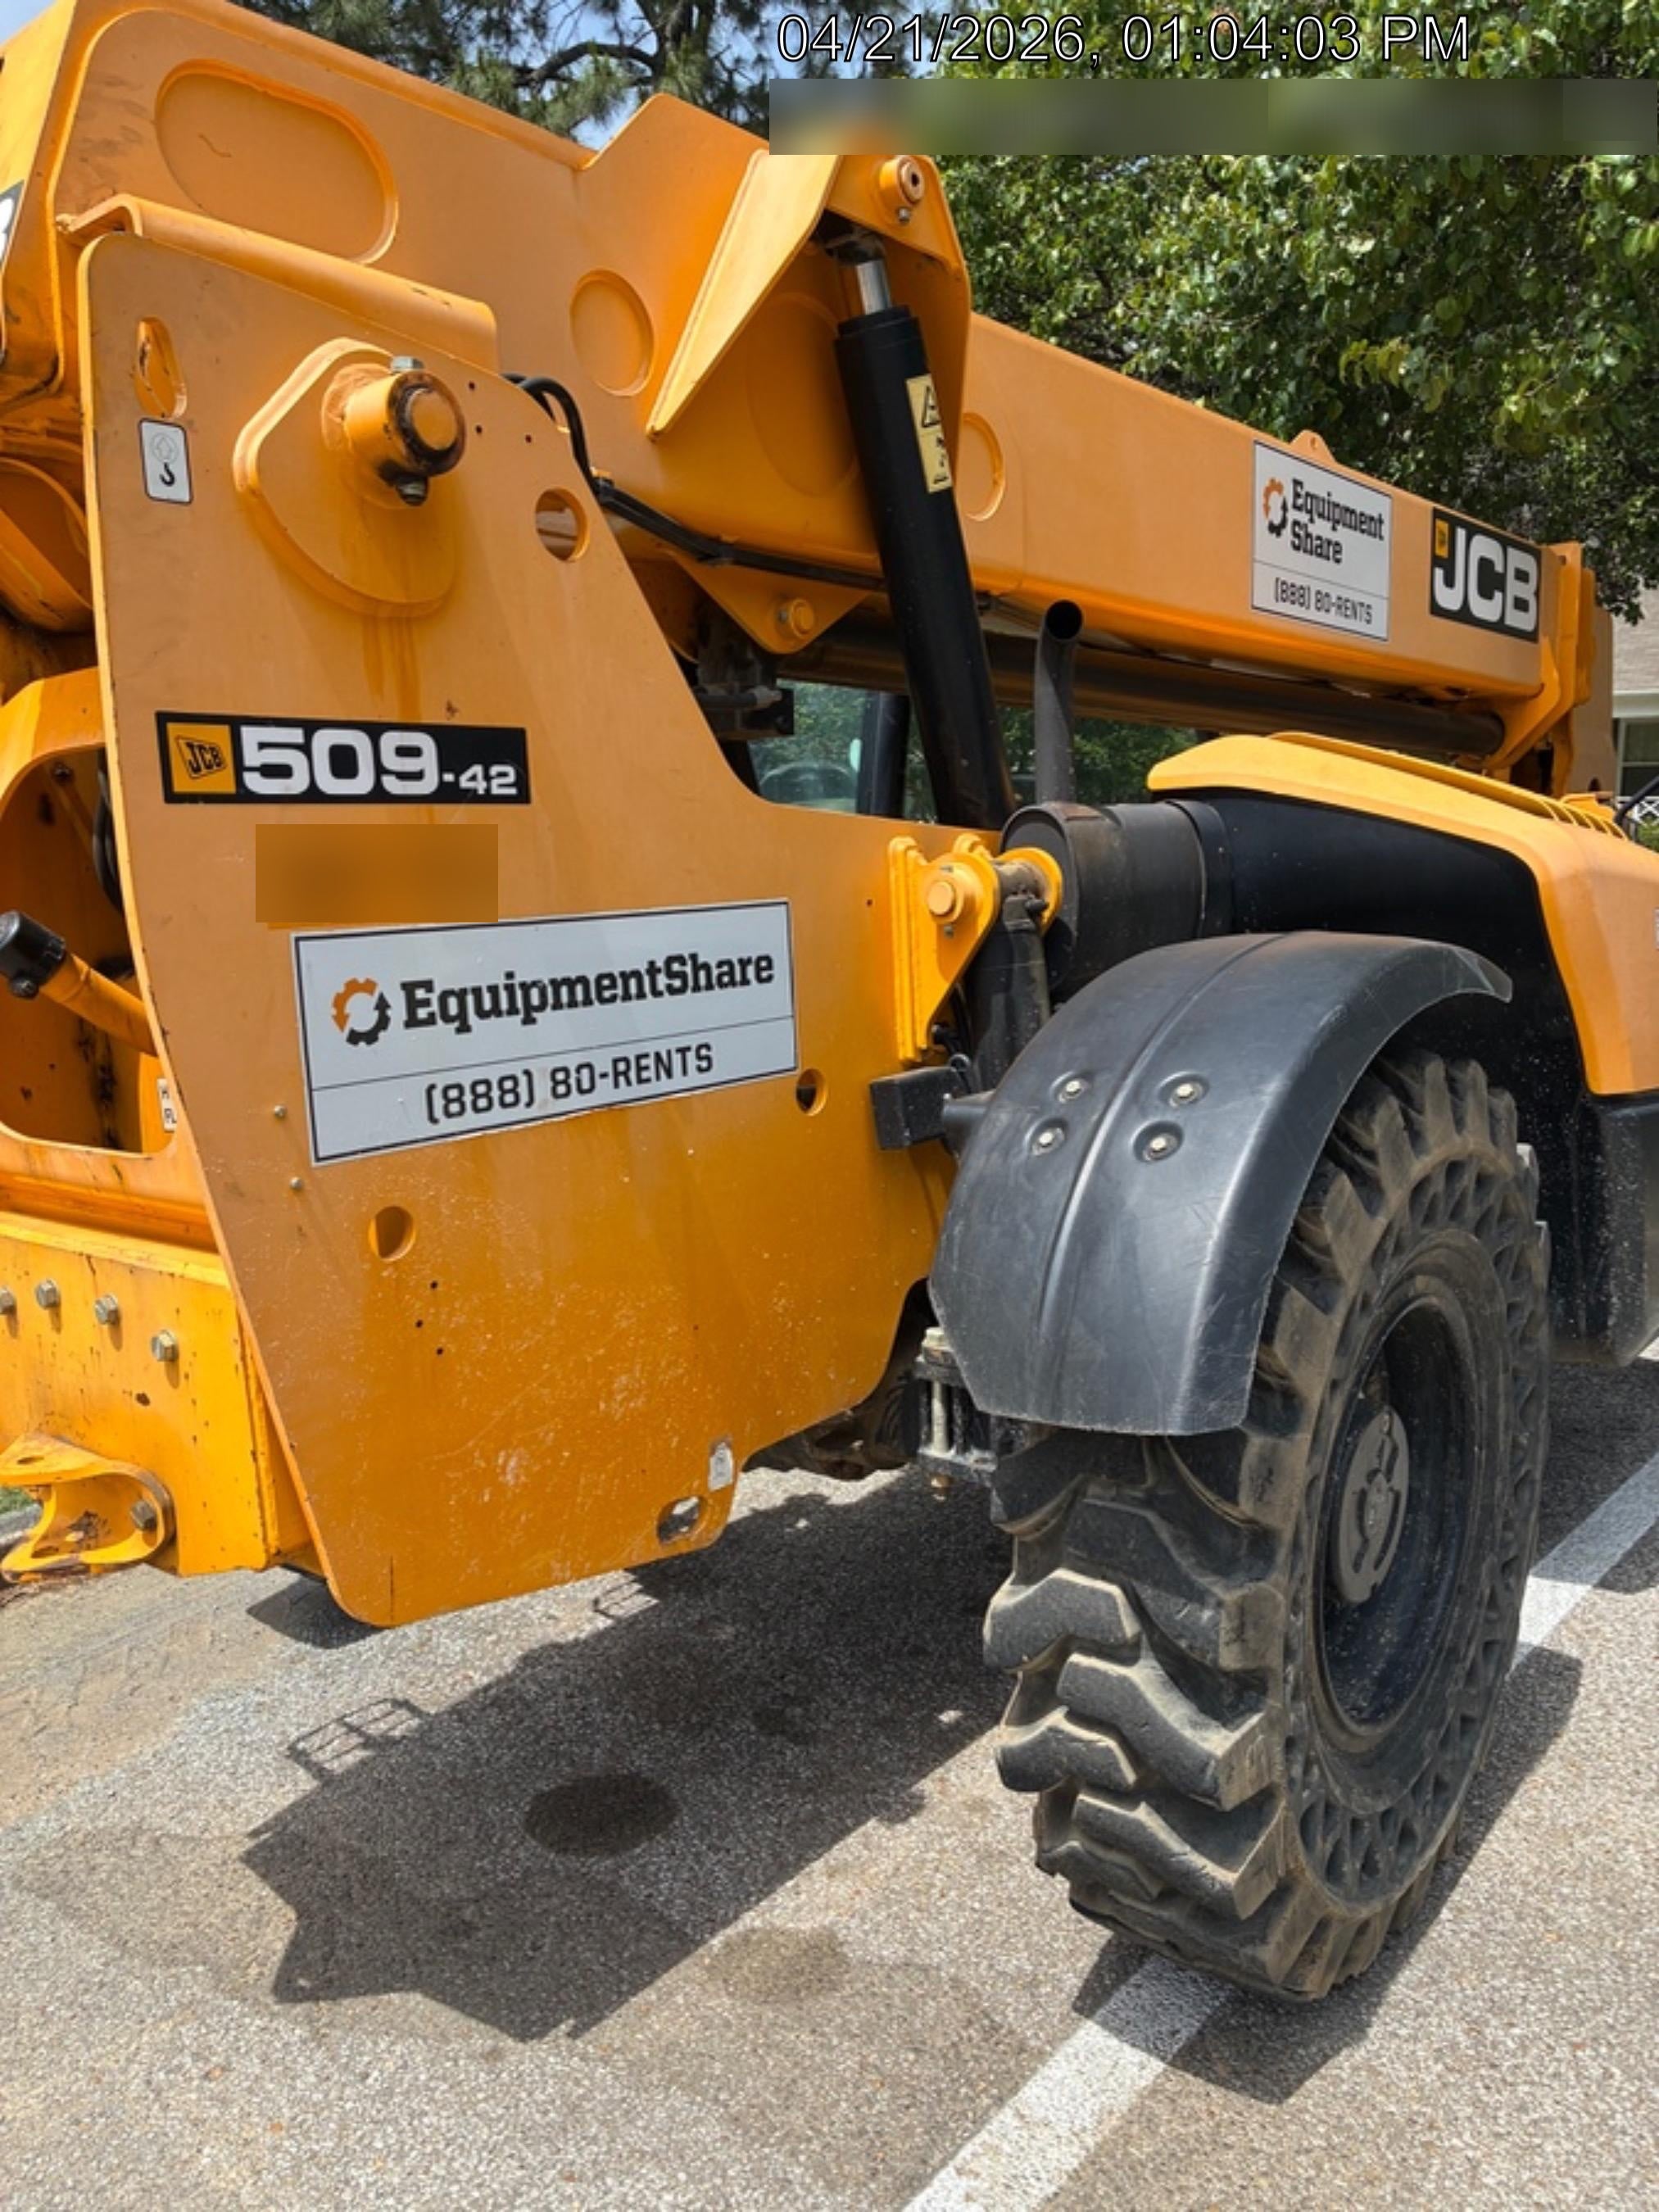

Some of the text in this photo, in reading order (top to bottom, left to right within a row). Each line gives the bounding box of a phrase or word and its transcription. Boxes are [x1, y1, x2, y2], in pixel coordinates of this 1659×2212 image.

[1291, 520, 1343, 564] Share
[1292, 478, 1385, 541] Equipment
[1275, 577, 1372, 624] (888) 80-RENTS
[1435, 527, 1537, 632] JCB
[186, 741, 224, 774] JCB
[239, 725, 517, 796] 509-42
[401, 953, 774, 1035] EquipmentShare
[426, 1044, 714, 1124] (888) 80-RENTS
